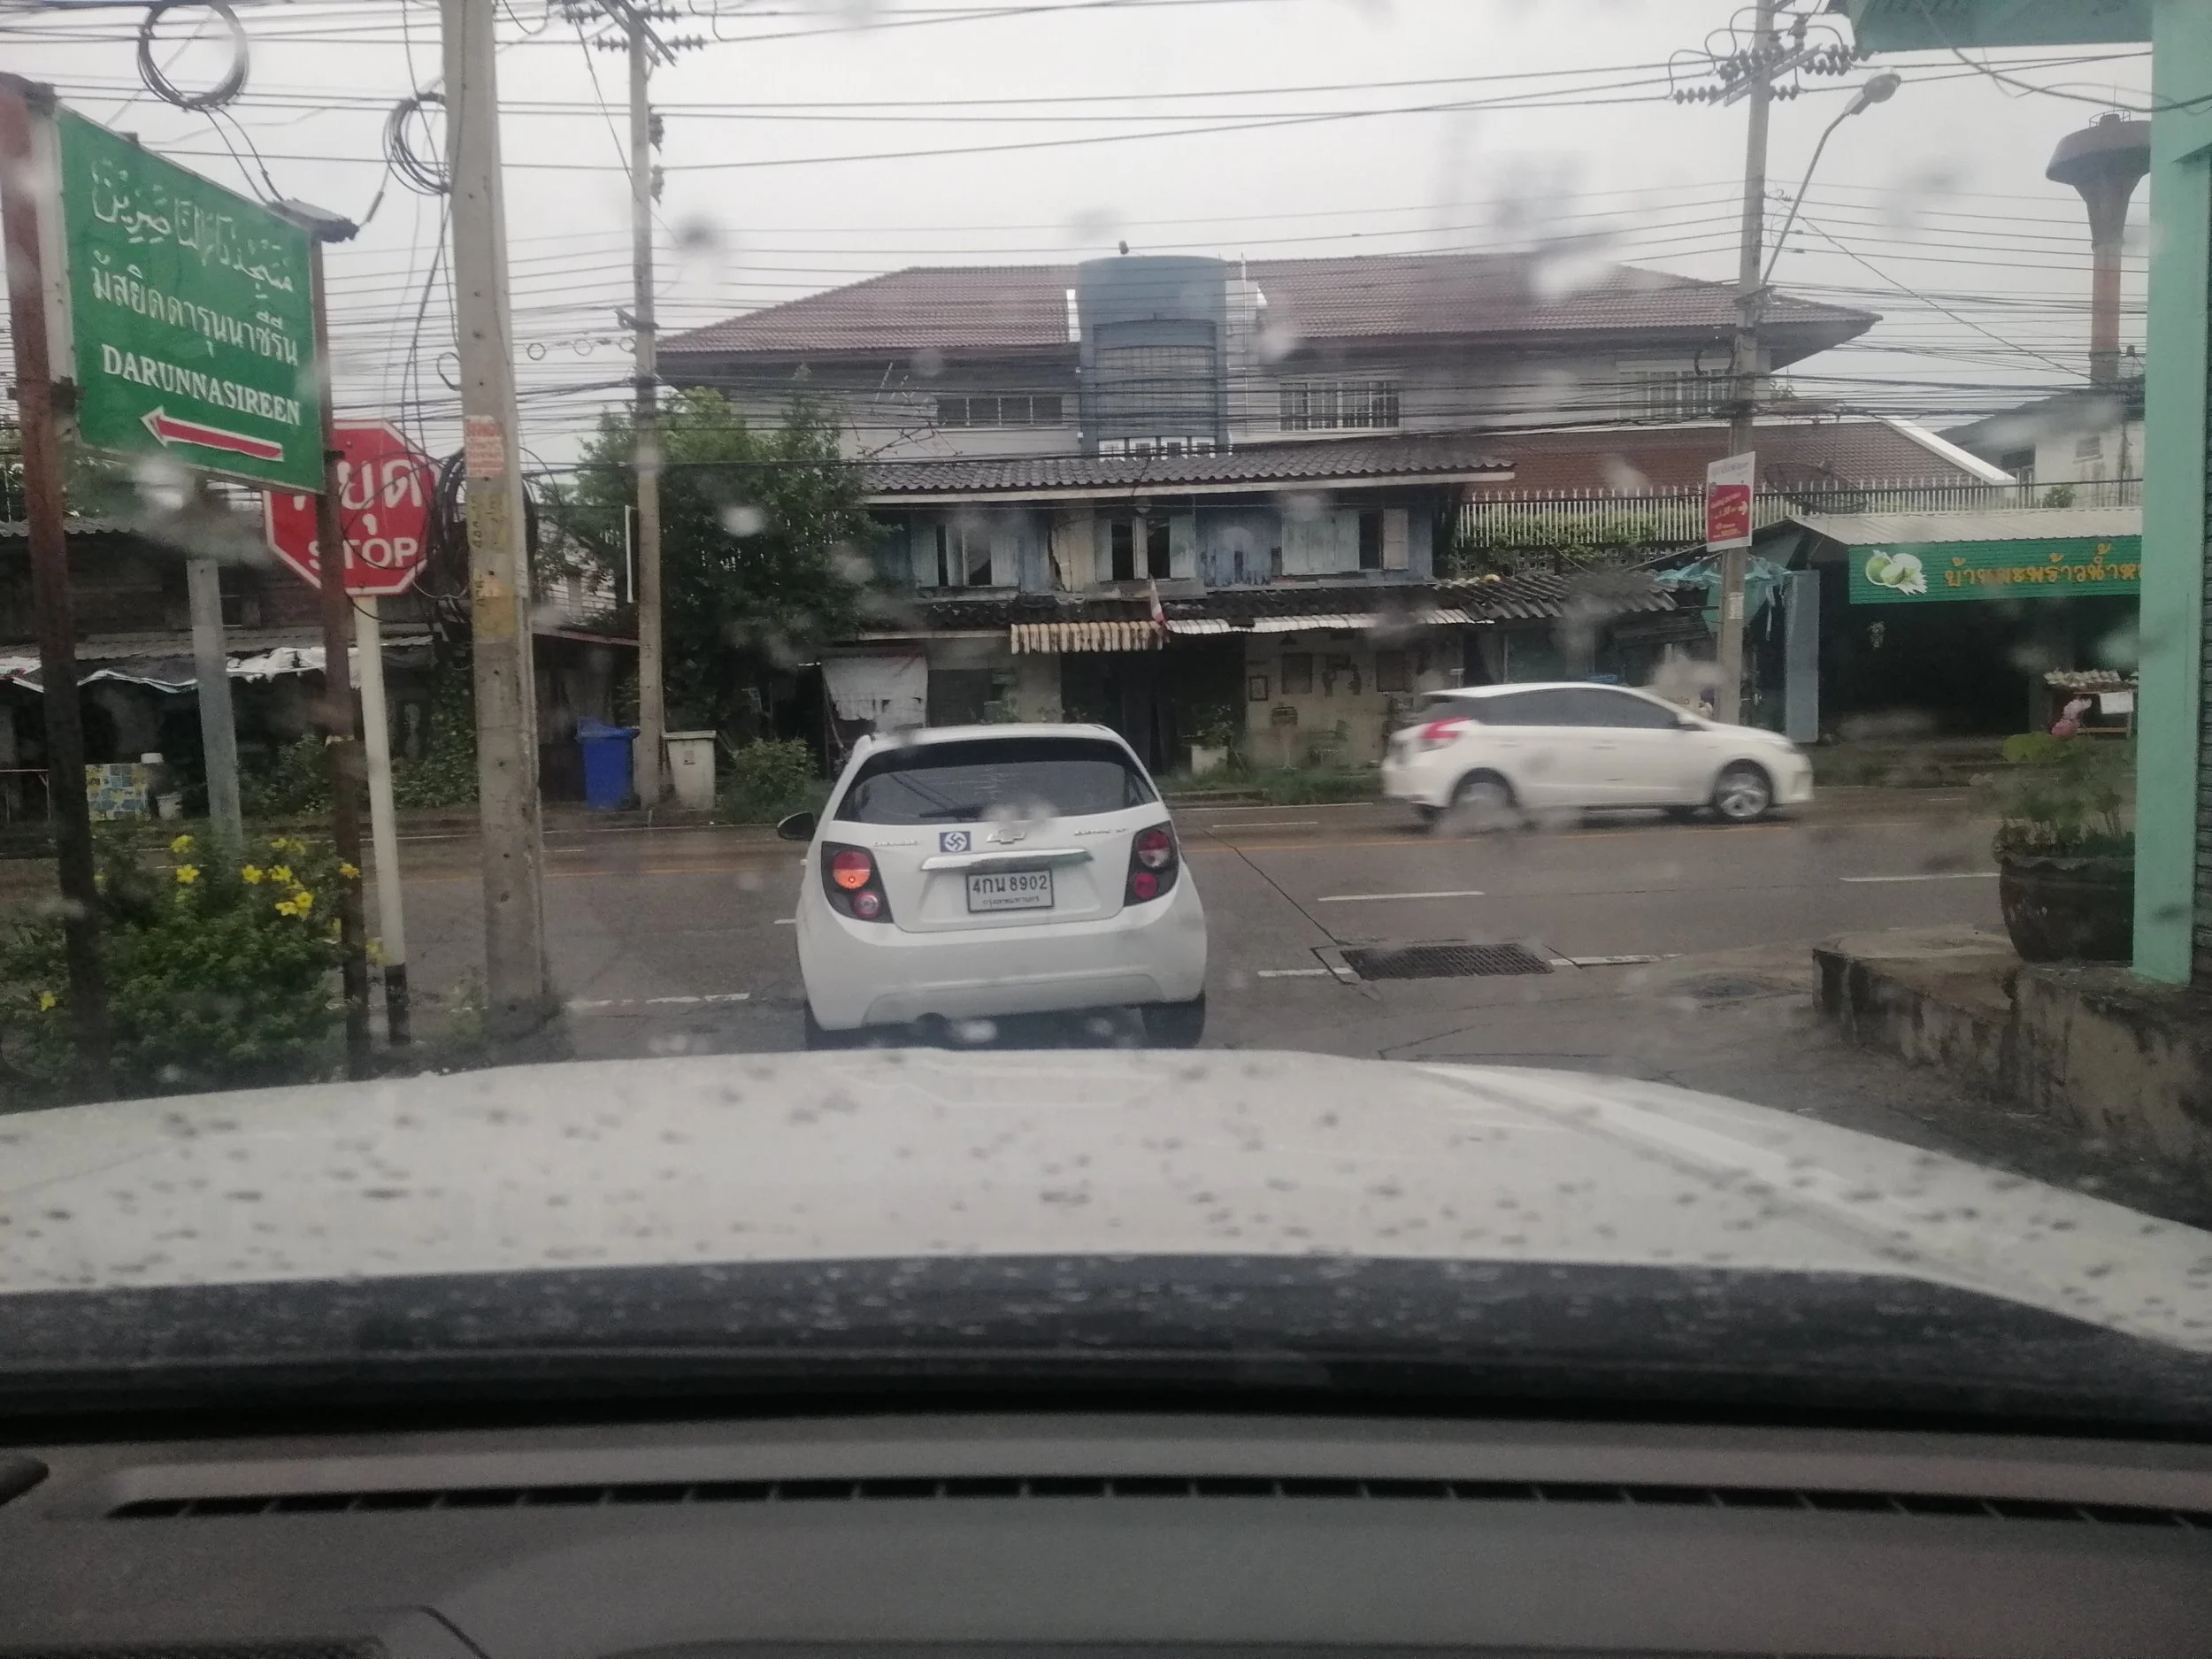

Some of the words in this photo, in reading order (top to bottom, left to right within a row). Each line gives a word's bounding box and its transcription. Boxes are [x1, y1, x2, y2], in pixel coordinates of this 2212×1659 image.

[102, 343, 302, 426] DARUNNASIREEN
[292, 458, 423, 536] ยุด
[1010, 874, 1048, 893] 8902
